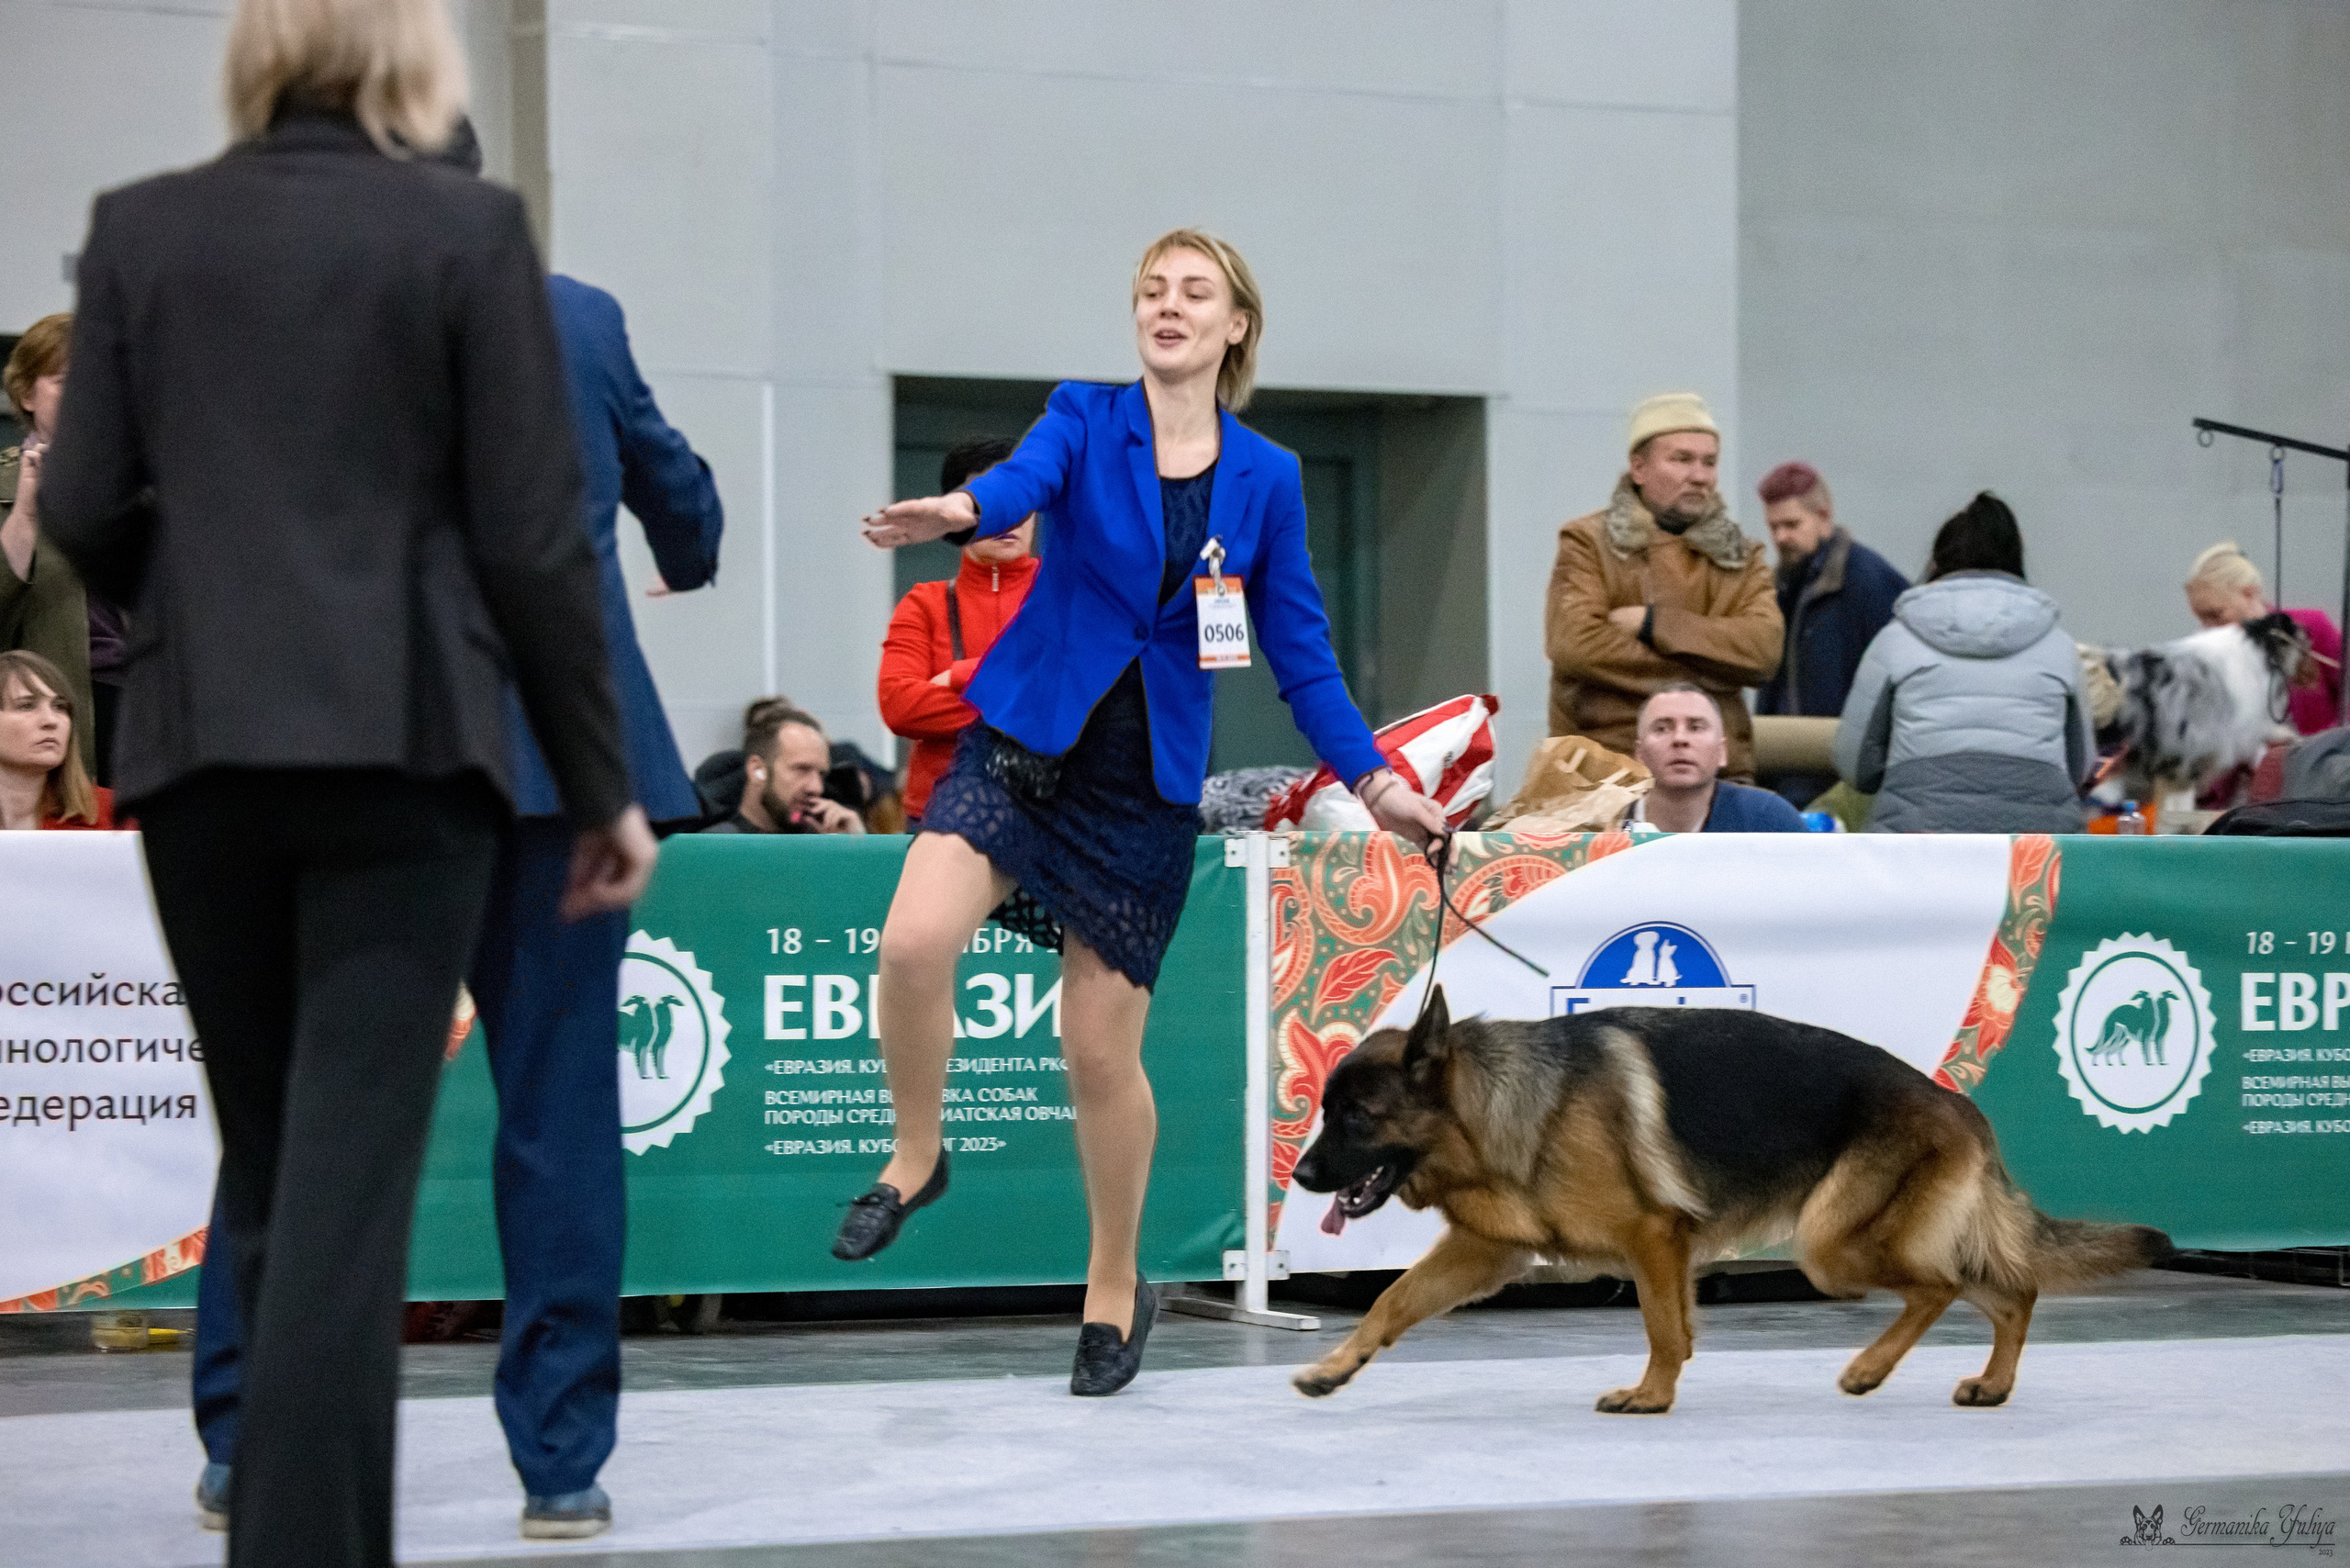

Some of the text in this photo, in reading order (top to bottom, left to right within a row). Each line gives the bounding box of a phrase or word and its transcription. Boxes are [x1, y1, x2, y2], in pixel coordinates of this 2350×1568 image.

[1204, 624, 1245, 643] 0506
[767, 928, 802, 954] 18
[845, 928, 880, 954] 19
[2245, 931, 2275, 955] 18
[2307, 931, 2336, 955] 19
[0, 972, 187, 1006] ссийска
[764, 972, 1063, 1039] ЕВЗИ
[2241, 972, 2350, 1032] ЕВР
[0, 1038, 206, 1063] нологиче
[2316, 1048, 2350, 1061] КУБО
[946, 1058, 1037, 1074] ЕЗИДЕНТА
[765, 1090, 875, 1104] ВСЕМИРНАЯ
[977, 1087, 1038, 1102] СОБАК
[765, 1109, 844, 1126] ПОРОДЫ
[1024, 1105, 1077, 1121] ОВЧА
[2316, 1120, 2350, 1134] КУБО
